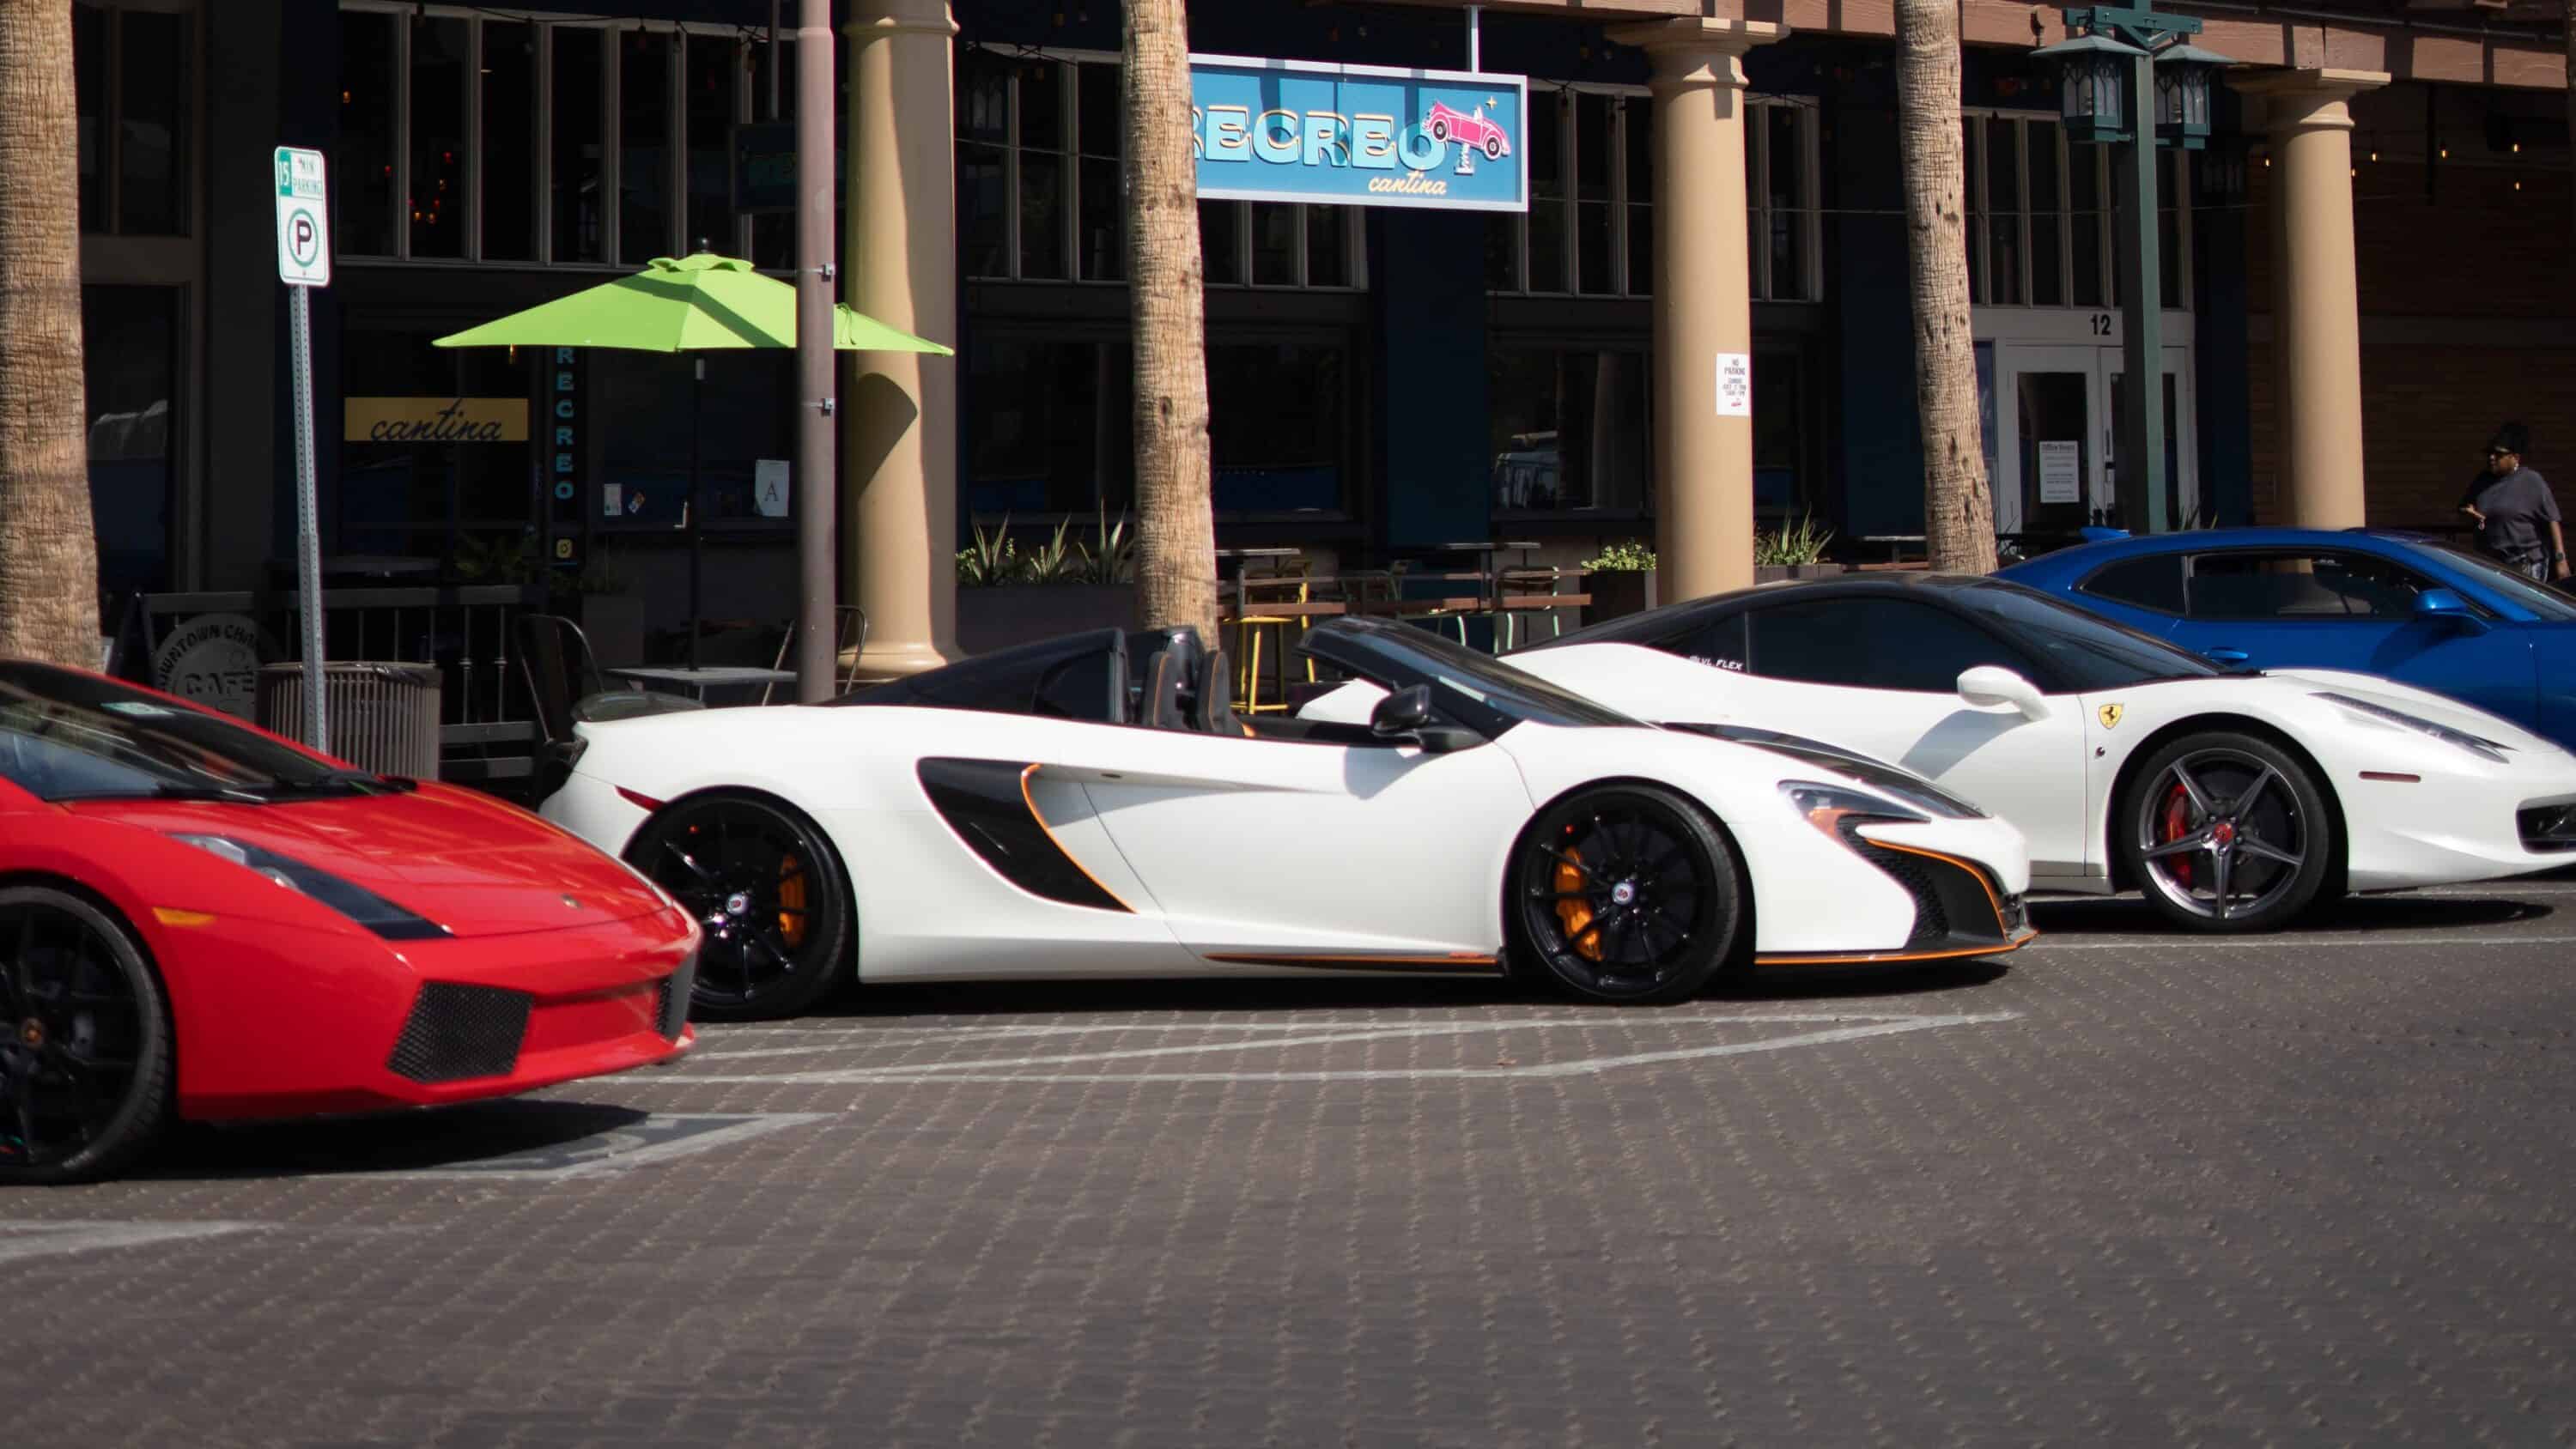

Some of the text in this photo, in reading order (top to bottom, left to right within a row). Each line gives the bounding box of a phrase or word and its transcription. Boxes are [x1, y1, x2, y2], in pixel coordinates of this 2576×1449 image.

[1193, 104, 1448, 171] ECREO
[279, 161, 289, 185] 15
[1368, 167, 1447, 195] cantina
[295, 219, 313, 256] P
[2090, 313, 2111, 336] 12
[370, 397, 502, 445] cantina
[556, 347, 575, 500] RECREO
[763, 481, 780, 502] A
[1716, 658, 1744, 670] FLEX
